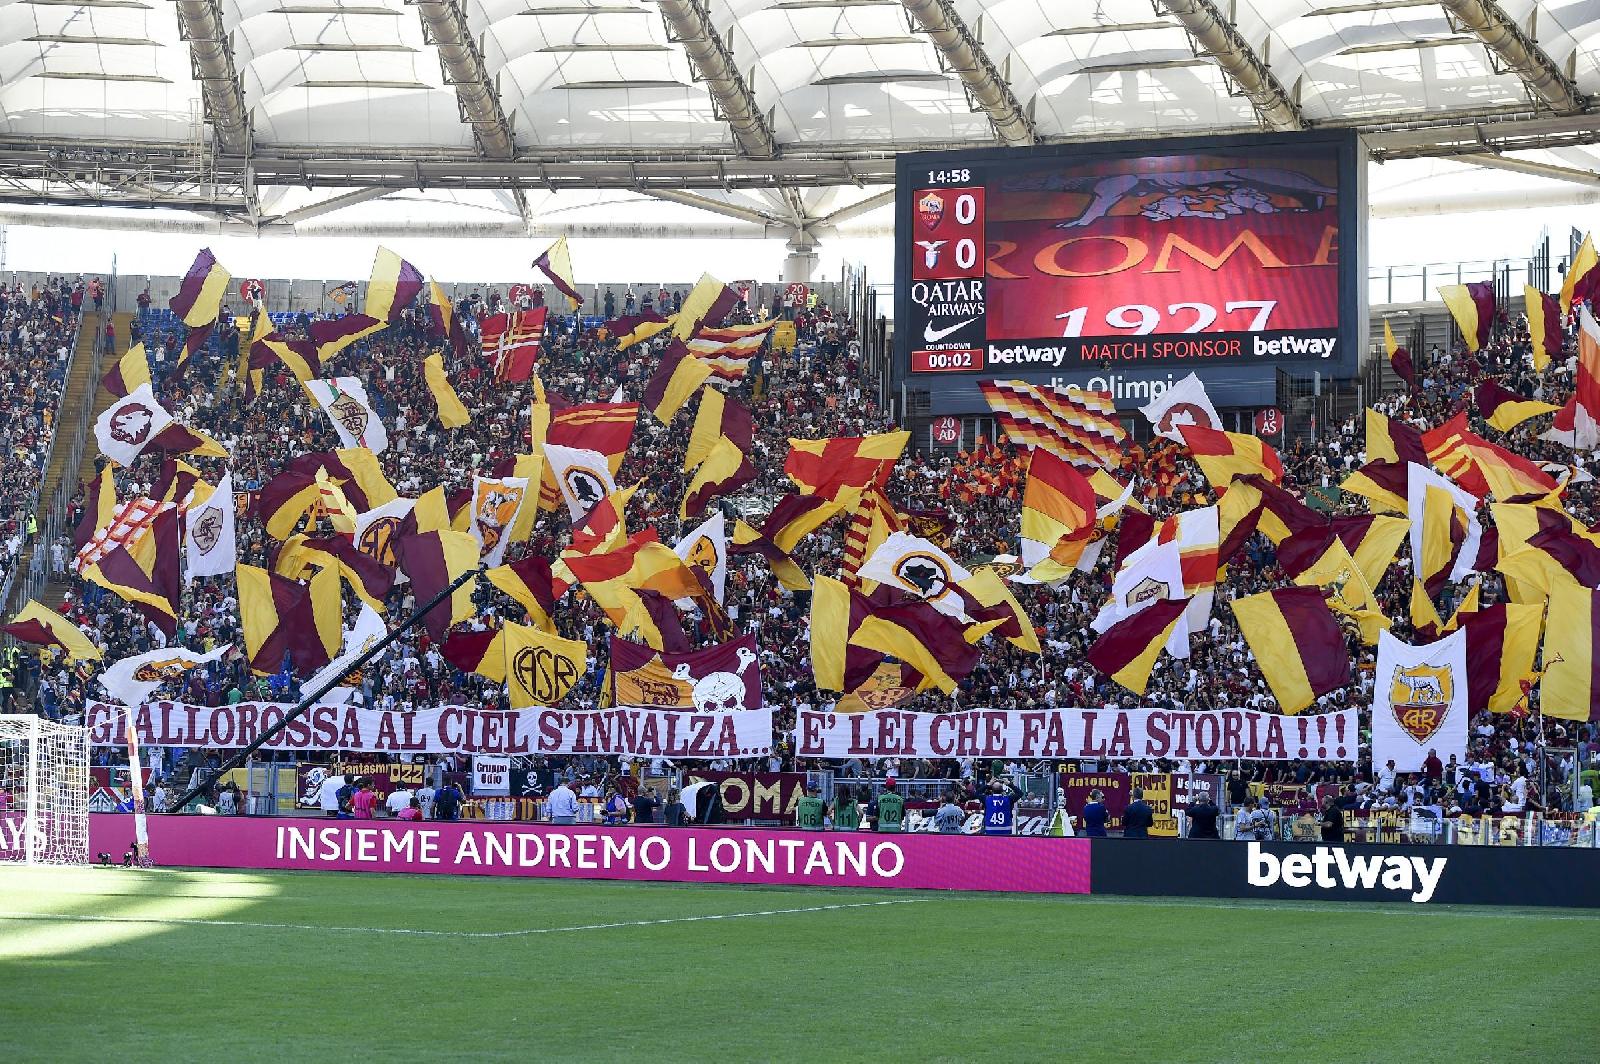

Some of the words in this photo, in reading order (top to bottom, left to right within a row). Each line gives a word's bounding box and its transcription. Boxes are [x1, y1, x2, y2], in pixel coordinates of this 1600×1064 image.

[928, 168, 971, 184] 14:58
[955, 194, 976, 225] 0
[955, 238, 976, 269] 0
[911, 280, 984, 308] QATAR
[927, 302, 985, 317] AIRWAYS
[925, 342, 971, 351] COUNTDOWN
[1081, 343, 1147, 361] MATCH
[1152, 340, 1241, 359] SPONSOR
[1253, 335, 1337, 358] betway
[928, 352, 972, 368] 00:02
[988, 344, 1067, 367] betway
[1087, 373, 1182, 405] Olimpi
[940, 416, 955, 429] 20
[1262, 409, 1276, 421] 19
[938, 429, 957, 441] AD
[1261, 420, 1277, 434] AS
[87, 703, 363, 749] GIALLOROSSA
[376, 711, 426, 750] AL
[437, 707, 529, 753] CIEL
[800, 712, 837, 754] E'
[848, 714, 918, 756] LEI
[929, 712, 1008, 757] CHE
[1018, 712, 1066, 757] FA
[1079, 712, 1135, 757] LA
[476, 763, 507, 774] Gruppo
[803, 813, 816, 826] 06
[884, 810, 898, 822] 02
[990, 811, 1005, 825] 49
[276, 826, 440, 865] INSIEME
[453, 831, 671, 872] ANDREMO
[687, 837, 905, 878] LONTANO
[1247, 841, 1447, 903] betway
